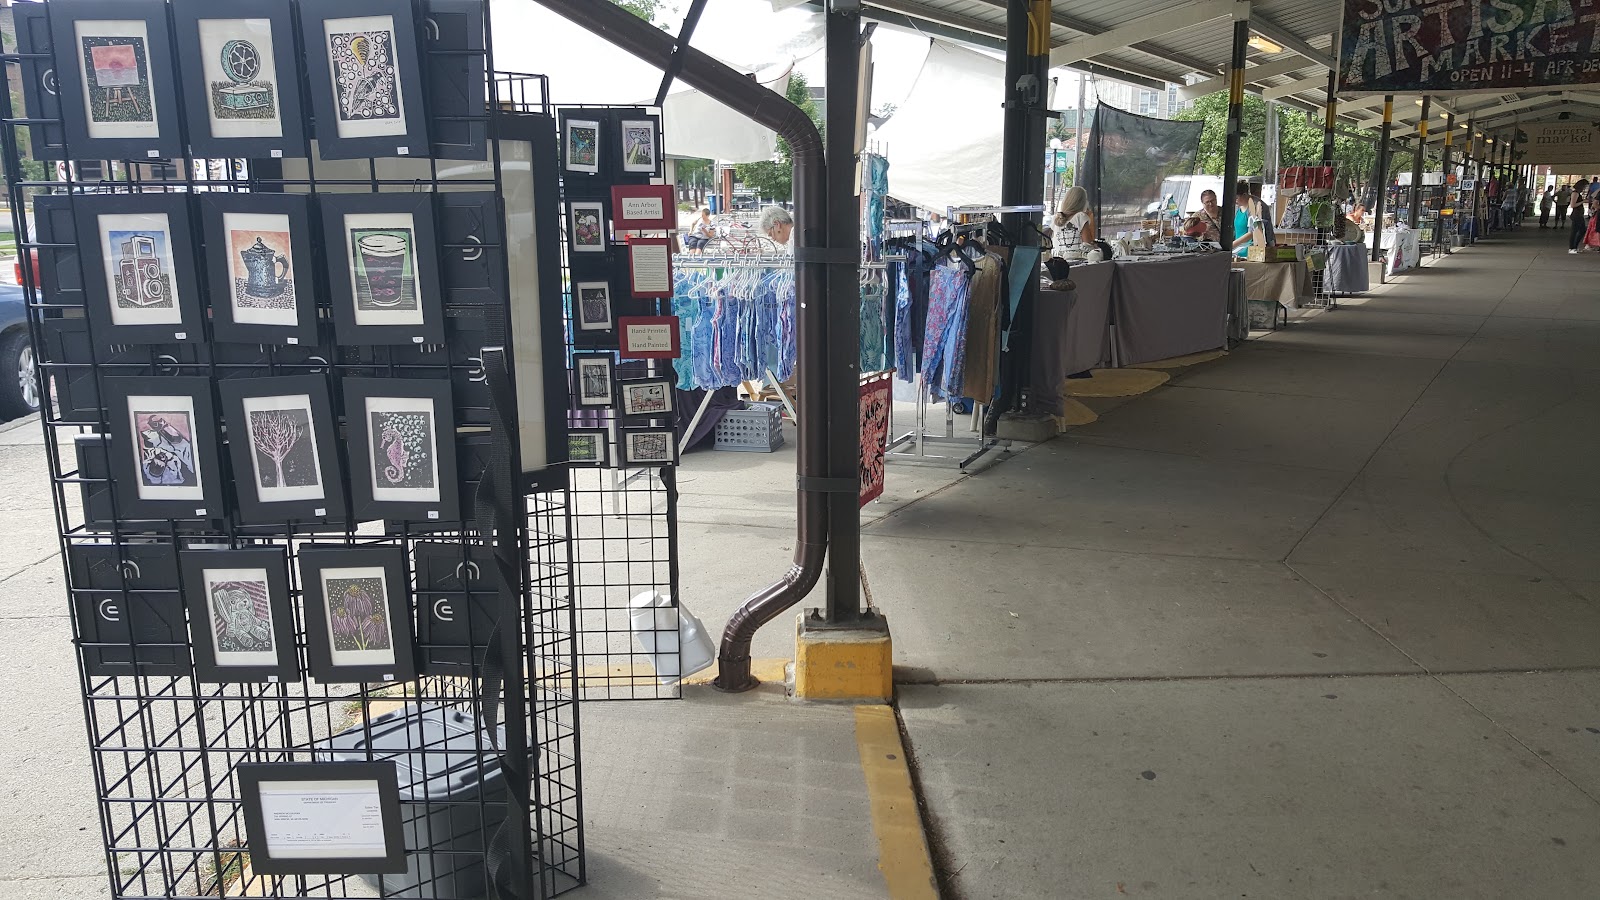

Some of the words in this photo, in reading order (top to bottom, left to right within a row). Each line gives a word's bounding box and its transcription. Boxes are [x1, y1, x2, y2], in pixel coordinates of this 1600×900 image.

[1449, 66, 1494, 83] OPEN
[1544, 58, 1600, 75] APR-DE
[1536, 131, 1592, 144] market
[1542, 127, 1587, 135] farmers
